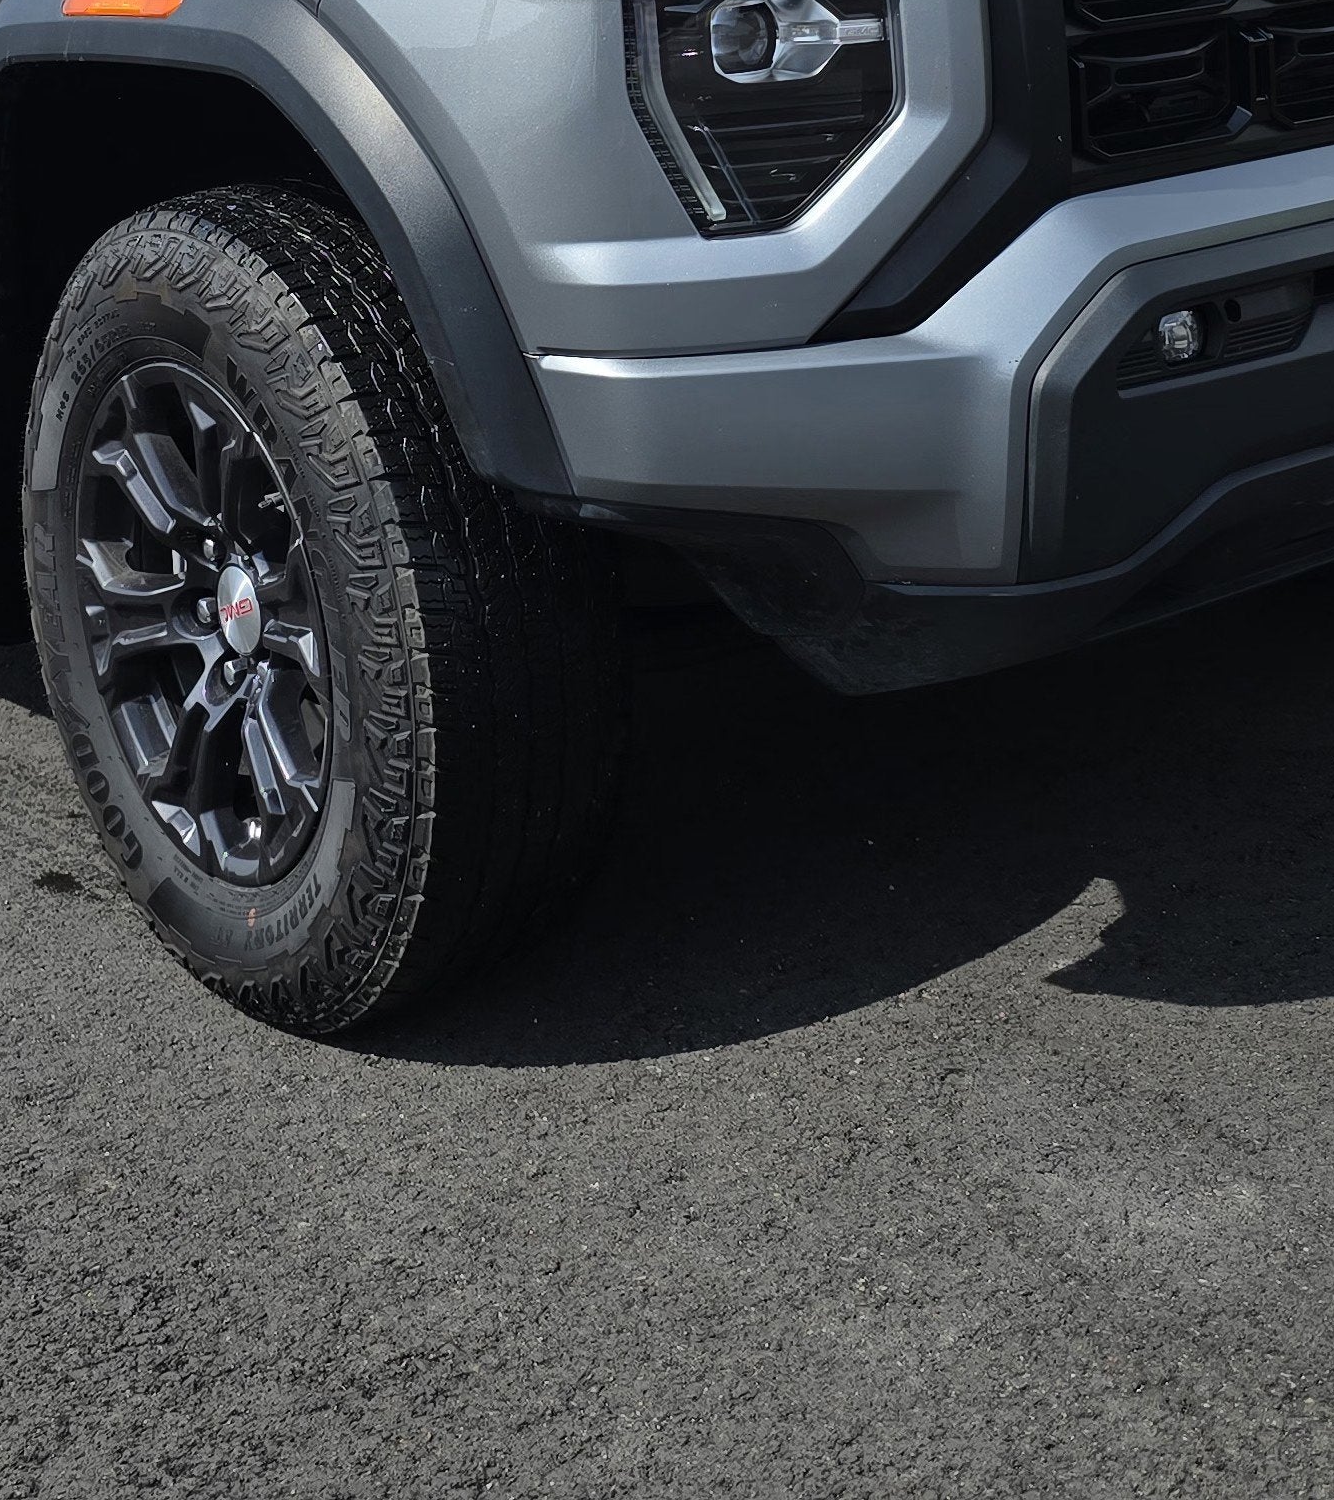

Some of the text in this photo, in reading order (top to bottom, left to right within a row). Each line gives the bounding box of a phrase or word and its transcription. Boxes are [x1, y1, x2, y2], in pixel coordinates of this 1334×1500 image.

[220, 597, 253, 622] GMC
[33, 521, 144, 871] GOODYEAR
[244, 872, 322, 951] TERRITORY
